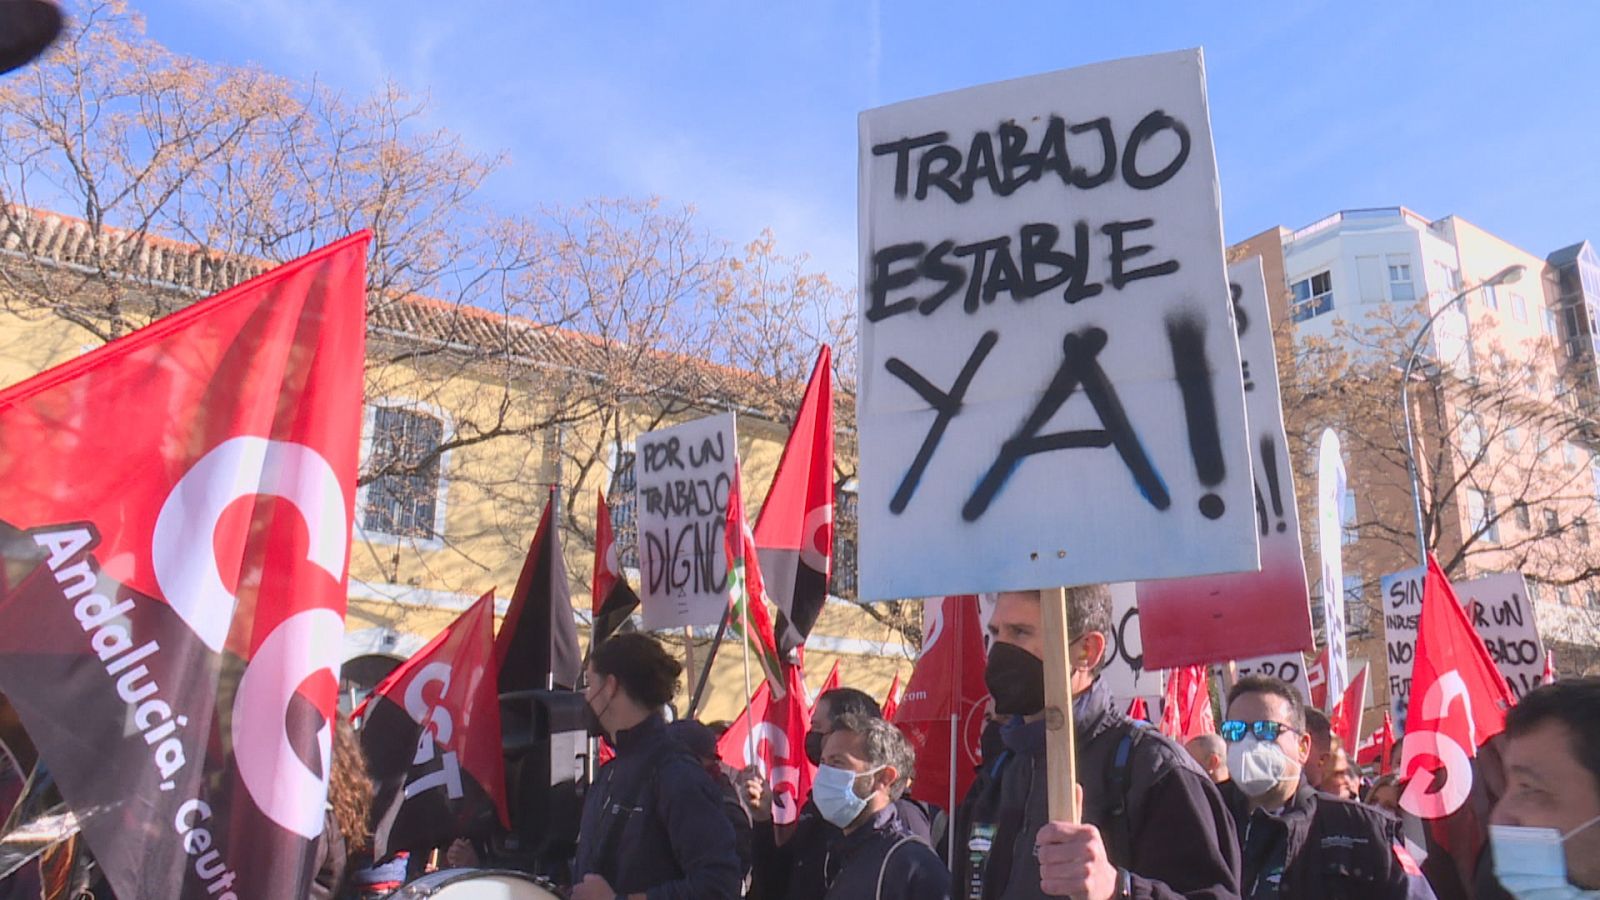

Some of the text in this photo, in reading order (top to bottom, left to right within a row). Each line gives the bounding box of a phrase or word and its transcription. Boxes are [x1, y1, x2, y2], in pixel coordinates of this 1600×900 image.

[873, 109, 1191, 203] TRABAJO
[865, 218, 1179, 322] ESTABLE
[885, 305, 1226, 523] YA!
[643, 430, 725, 473] POR UN
[640, 471, 731, 520] TRABAJO
[645, 515, 728, 596] DIGNO
[1390, 575, 1426, 609] SIN
[1491, 593, 1524, 628] UN
[1386, 614, 1421, 633] INDUST
[1387, 640, 1413, 665] NO
[1484, 637, 1539, 667] BAJO
[1389, 674, 1413, 698] FUT
